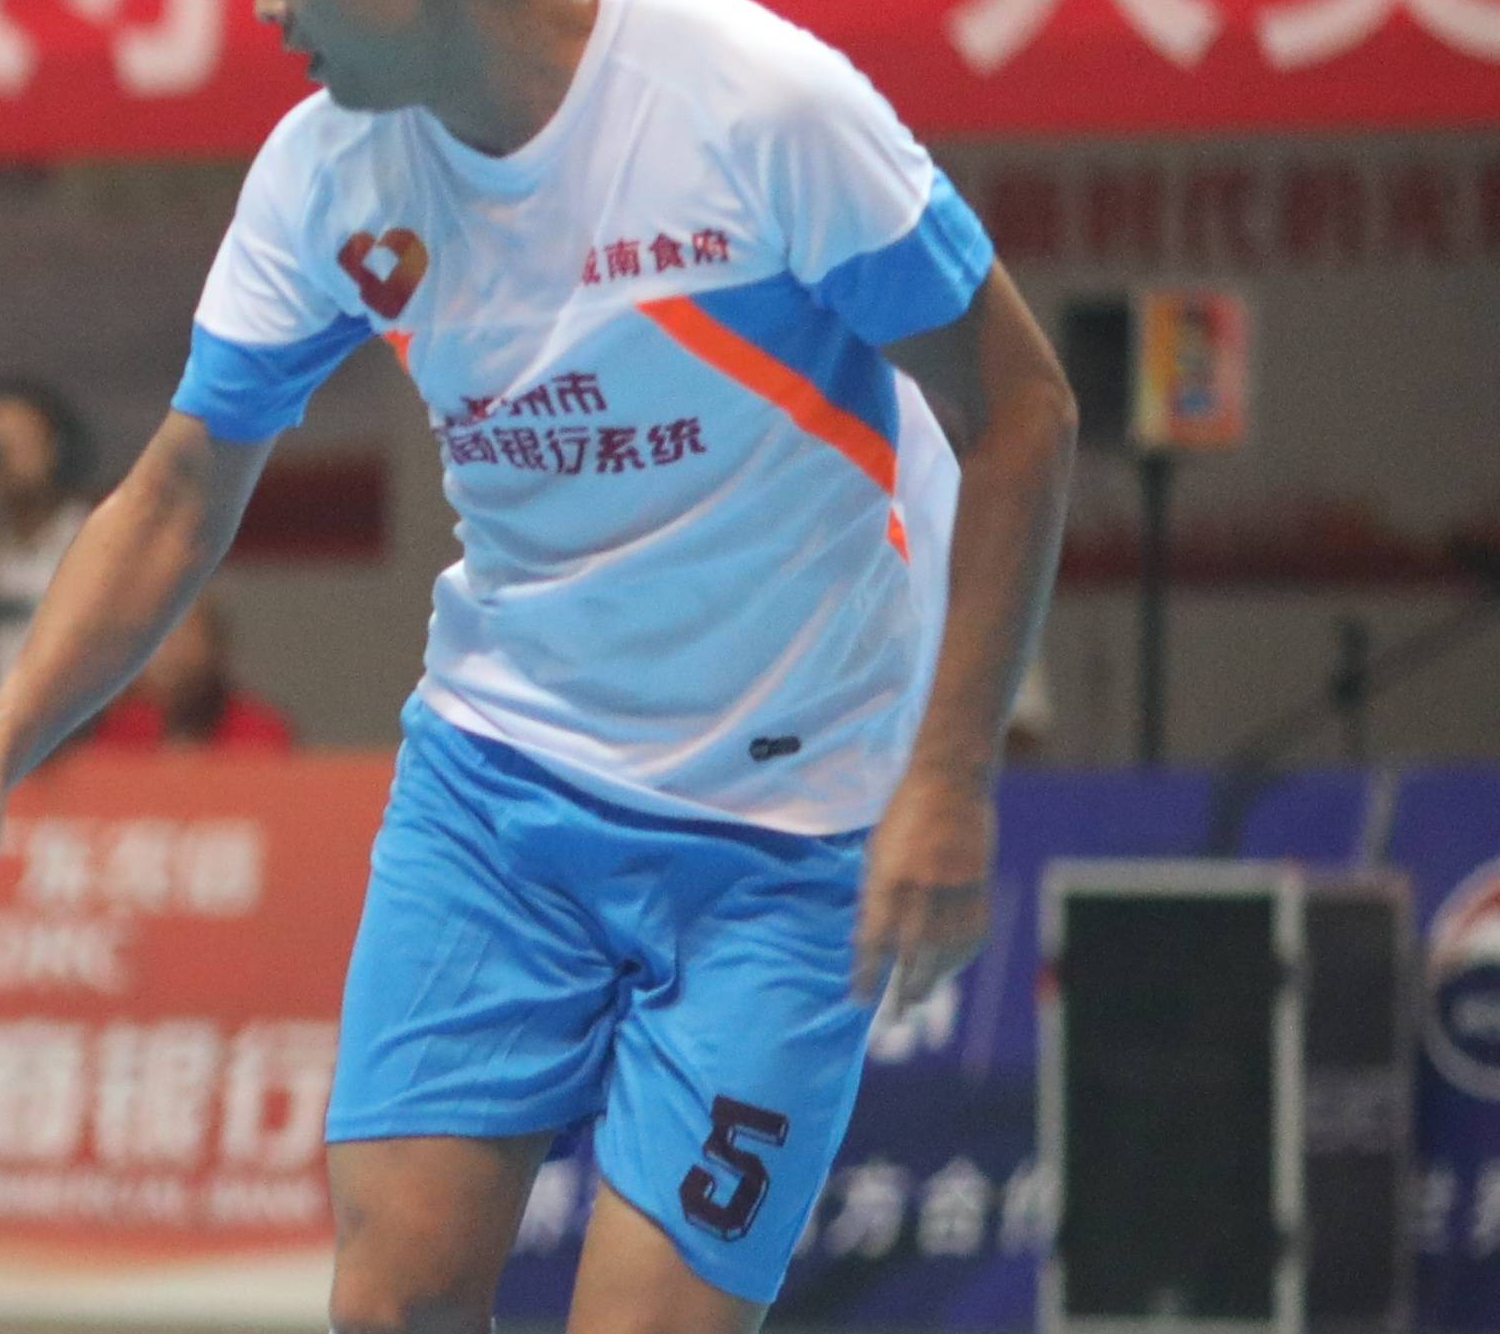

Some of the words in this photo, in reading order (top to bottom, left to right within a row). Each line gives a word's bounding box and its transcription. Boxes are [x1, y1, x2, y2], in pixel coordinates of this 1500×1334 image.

[434, 417, 707, 475] 商银行系统
[677, 1093, 790, 1243] 5
